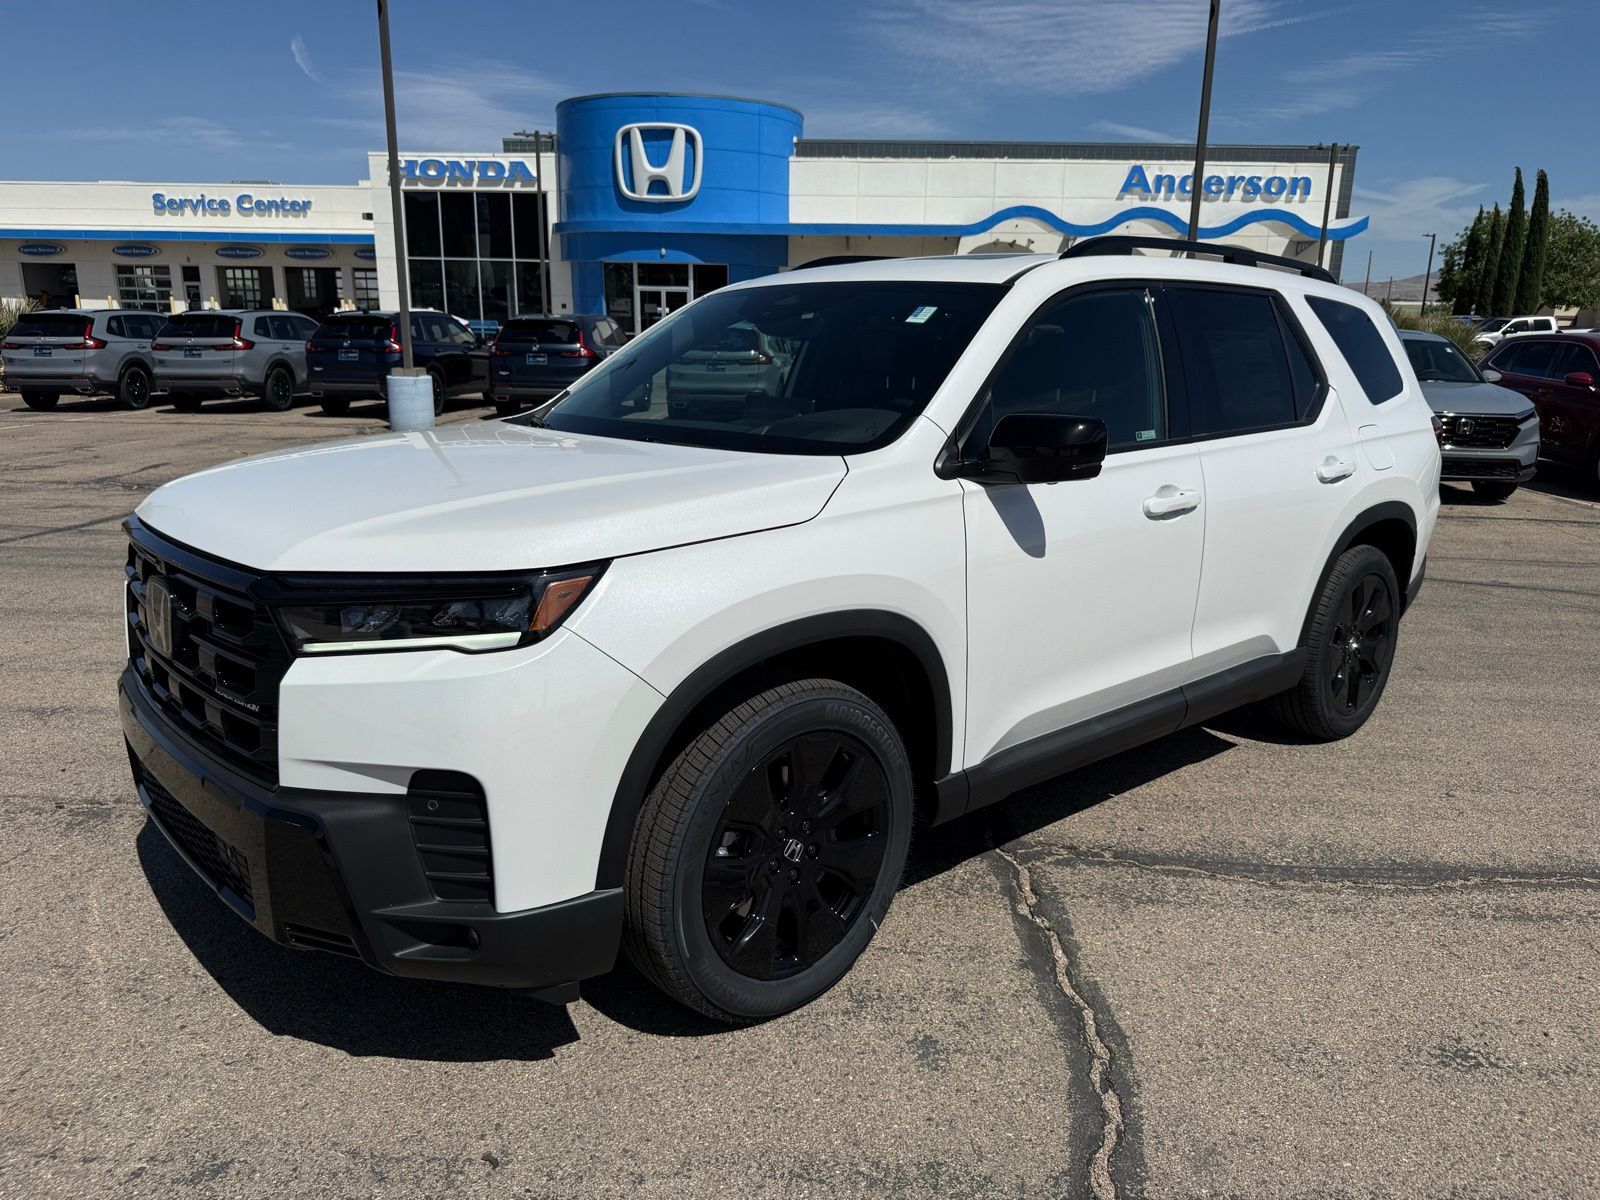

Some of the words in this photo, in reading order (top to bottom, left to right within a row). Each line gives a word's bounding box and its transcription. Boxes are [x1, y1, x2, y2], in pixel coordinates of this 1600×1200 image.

[388, 158, 537, 180] HONDA
[1119, 164, 1312, 196] Anderson
[152, 193, 231, 212] Service
[236, 194, 313, 213] Center
